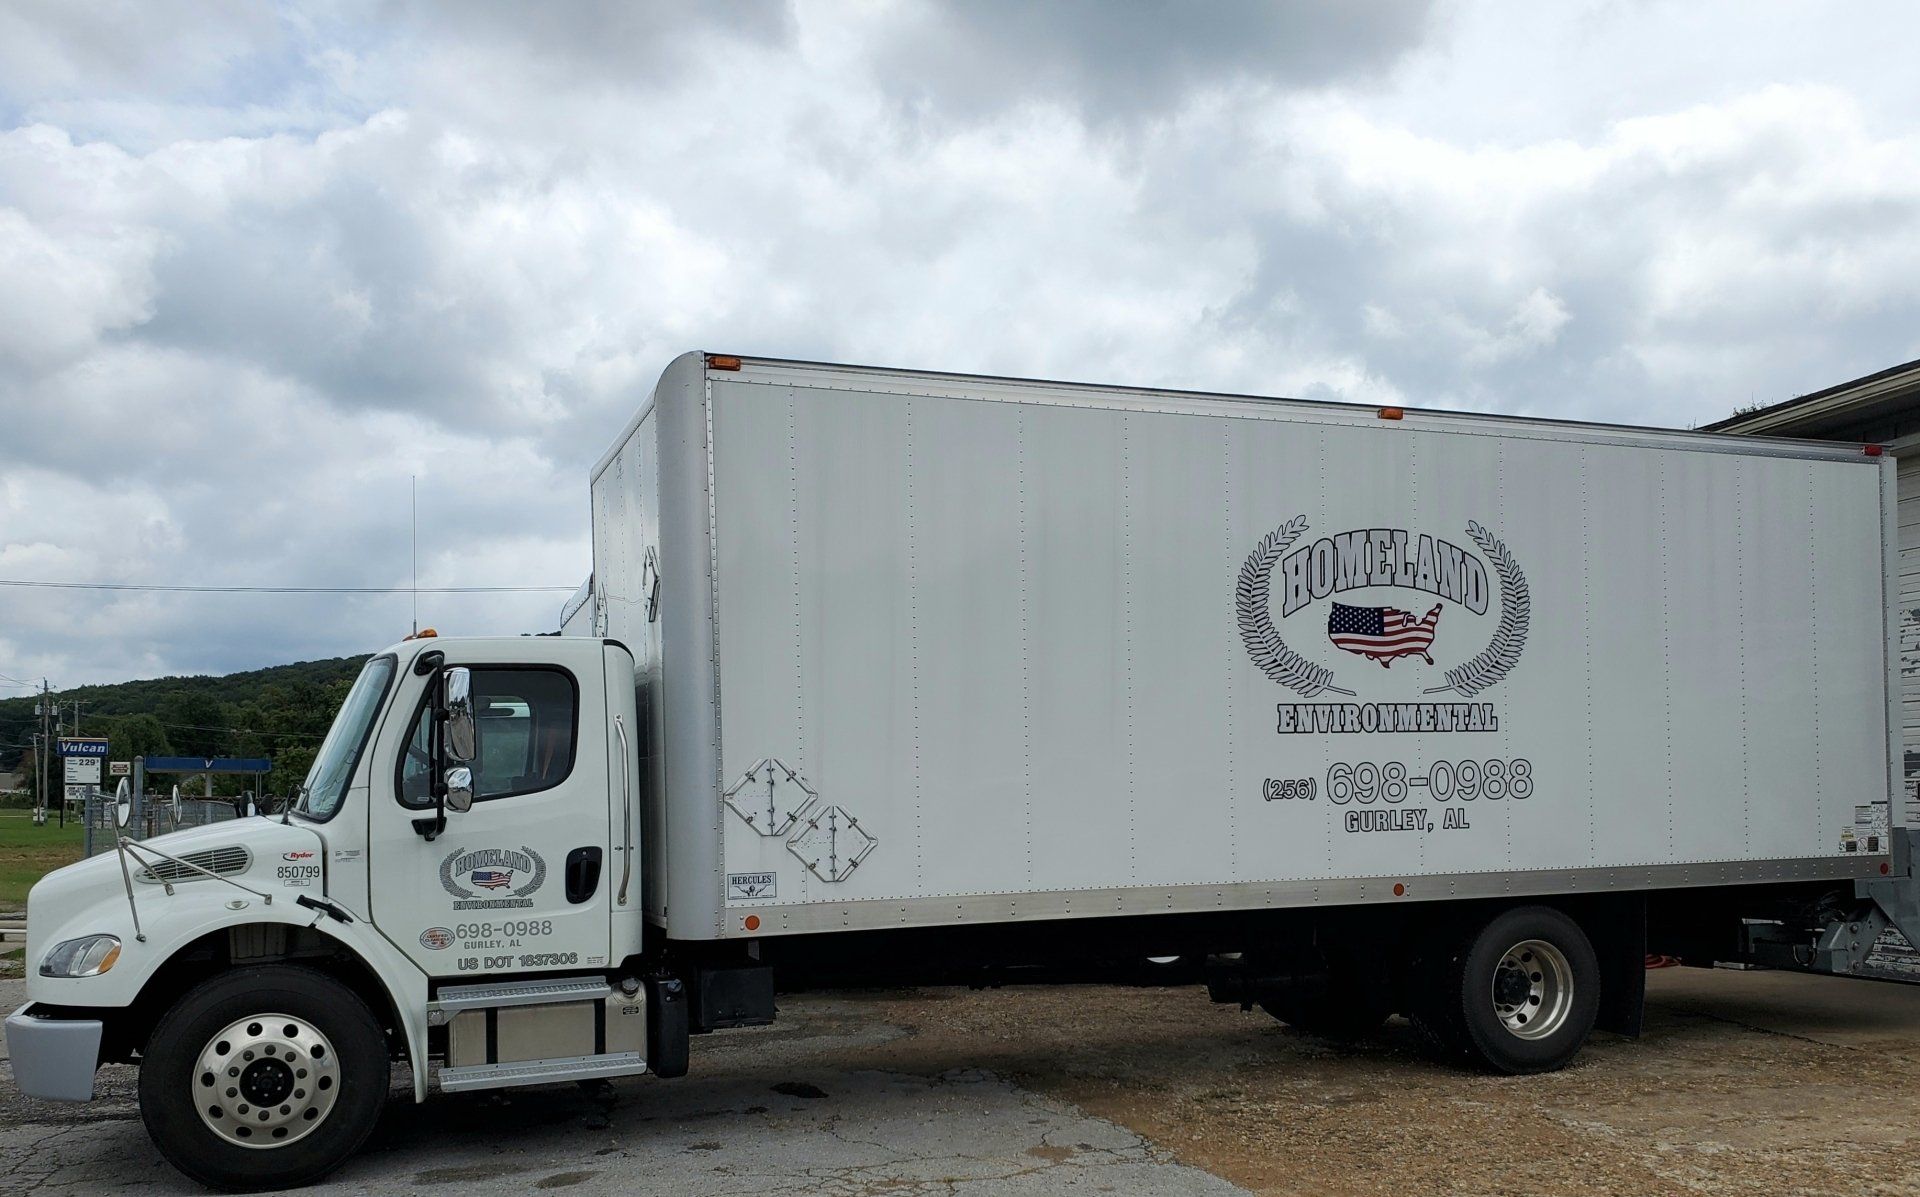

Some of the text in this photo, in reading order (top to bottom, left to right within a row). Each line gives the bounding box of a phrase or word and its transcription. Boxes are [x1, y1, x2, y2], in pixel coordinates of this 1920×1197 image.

[1282, 528, 1489, 618] HOMELAND
[1277, 703, 1498, 734] ENVIRONMENTAL
[62, 742, 105, 753] Vulcan
[1263, 758, 1533, 804] (256) 698-0988
[1345, 808, 1470, 833] GURLEY, AL
[290, 851, 315, 860] Ryder
[455, 849, 532, 877] HOMELAND
[277, 865, 320, 879] 850799
[732, 875, 772, 885] HERCULES
[453, 898, 533, 911] ENVIRONMENTAL
[456, 920, 553, 939] 698-0988
[509, 938, 522, 947] AL
[458, 957, 478, 970] US
[484, 955, 514, 969] DOT
[519, 952, 578, 967] 1837306
